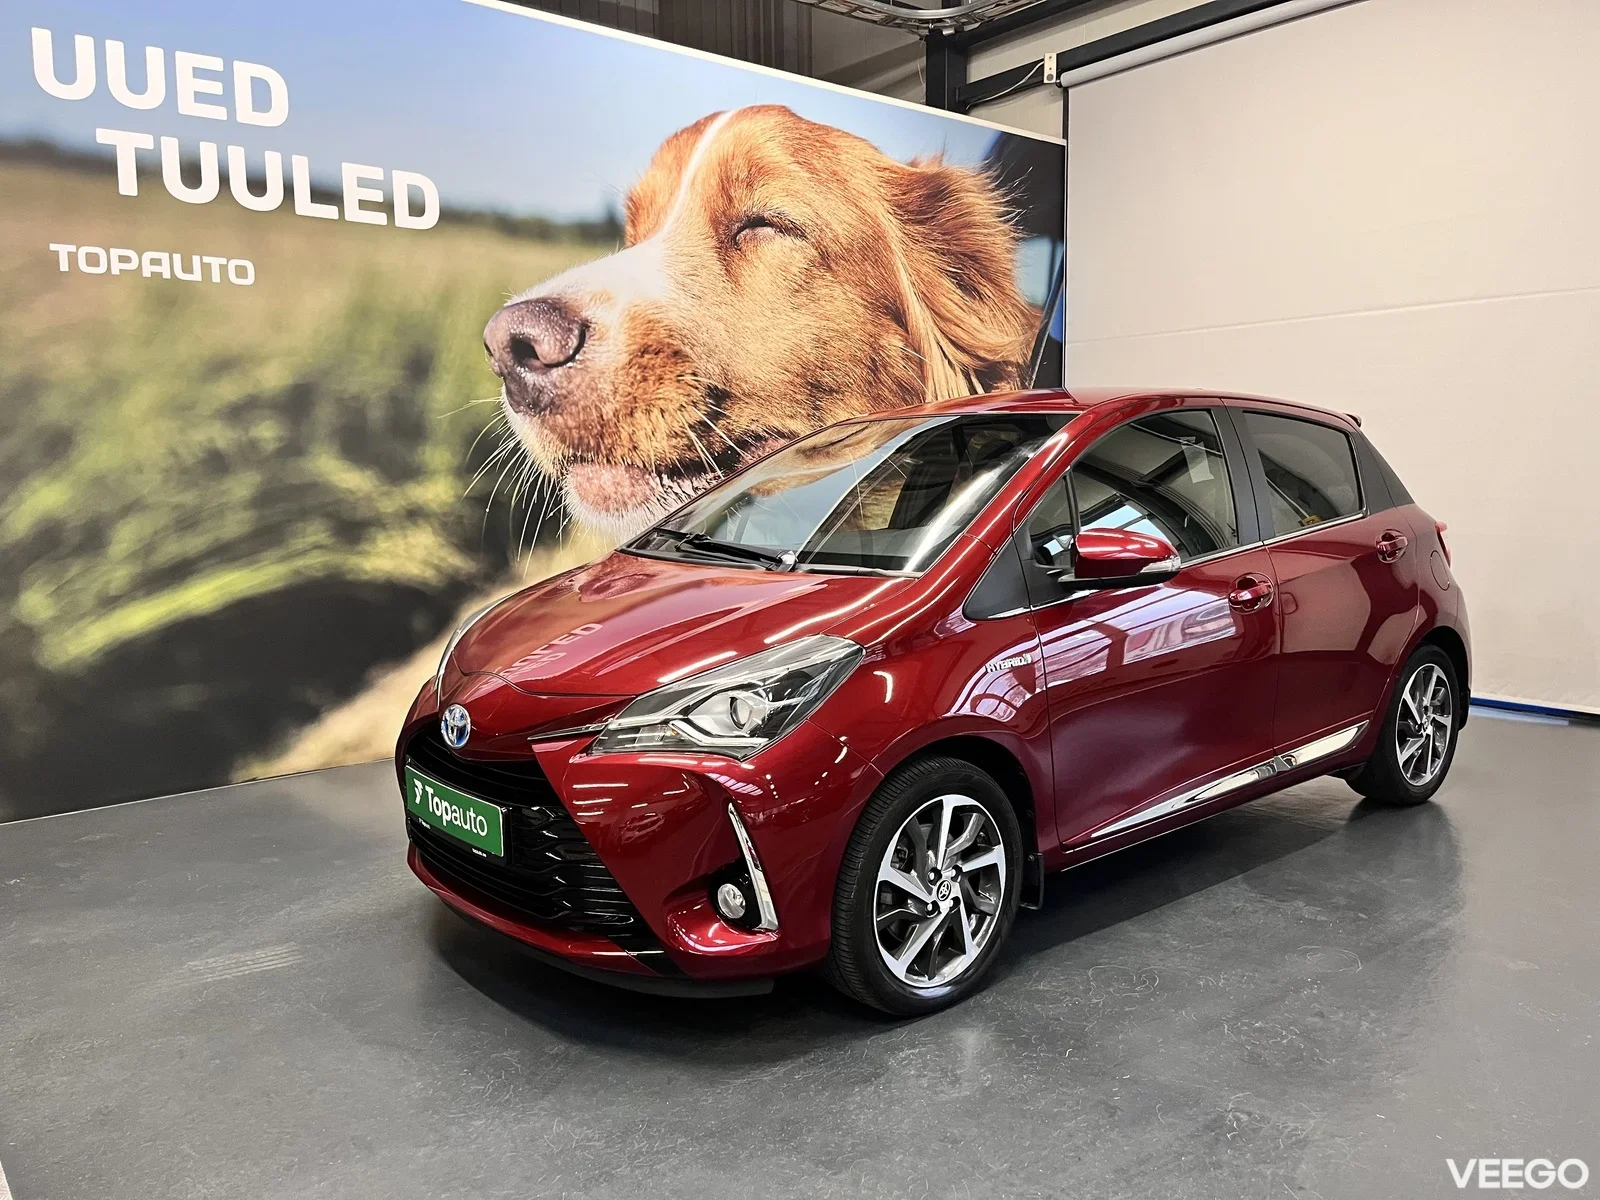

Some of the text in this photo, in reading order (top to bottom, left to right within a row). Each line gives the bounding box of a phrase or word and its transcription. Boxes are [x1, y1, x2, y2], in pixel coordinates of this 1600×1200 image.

[31, 27, 289, 127] UUED
[96, 128, 440, 230] TUULED
[49, 243, 256, 286] TOPAUTO
[986, 656, 1025, 672] HYBRID
[425, 785, 488, 836] Topauto
